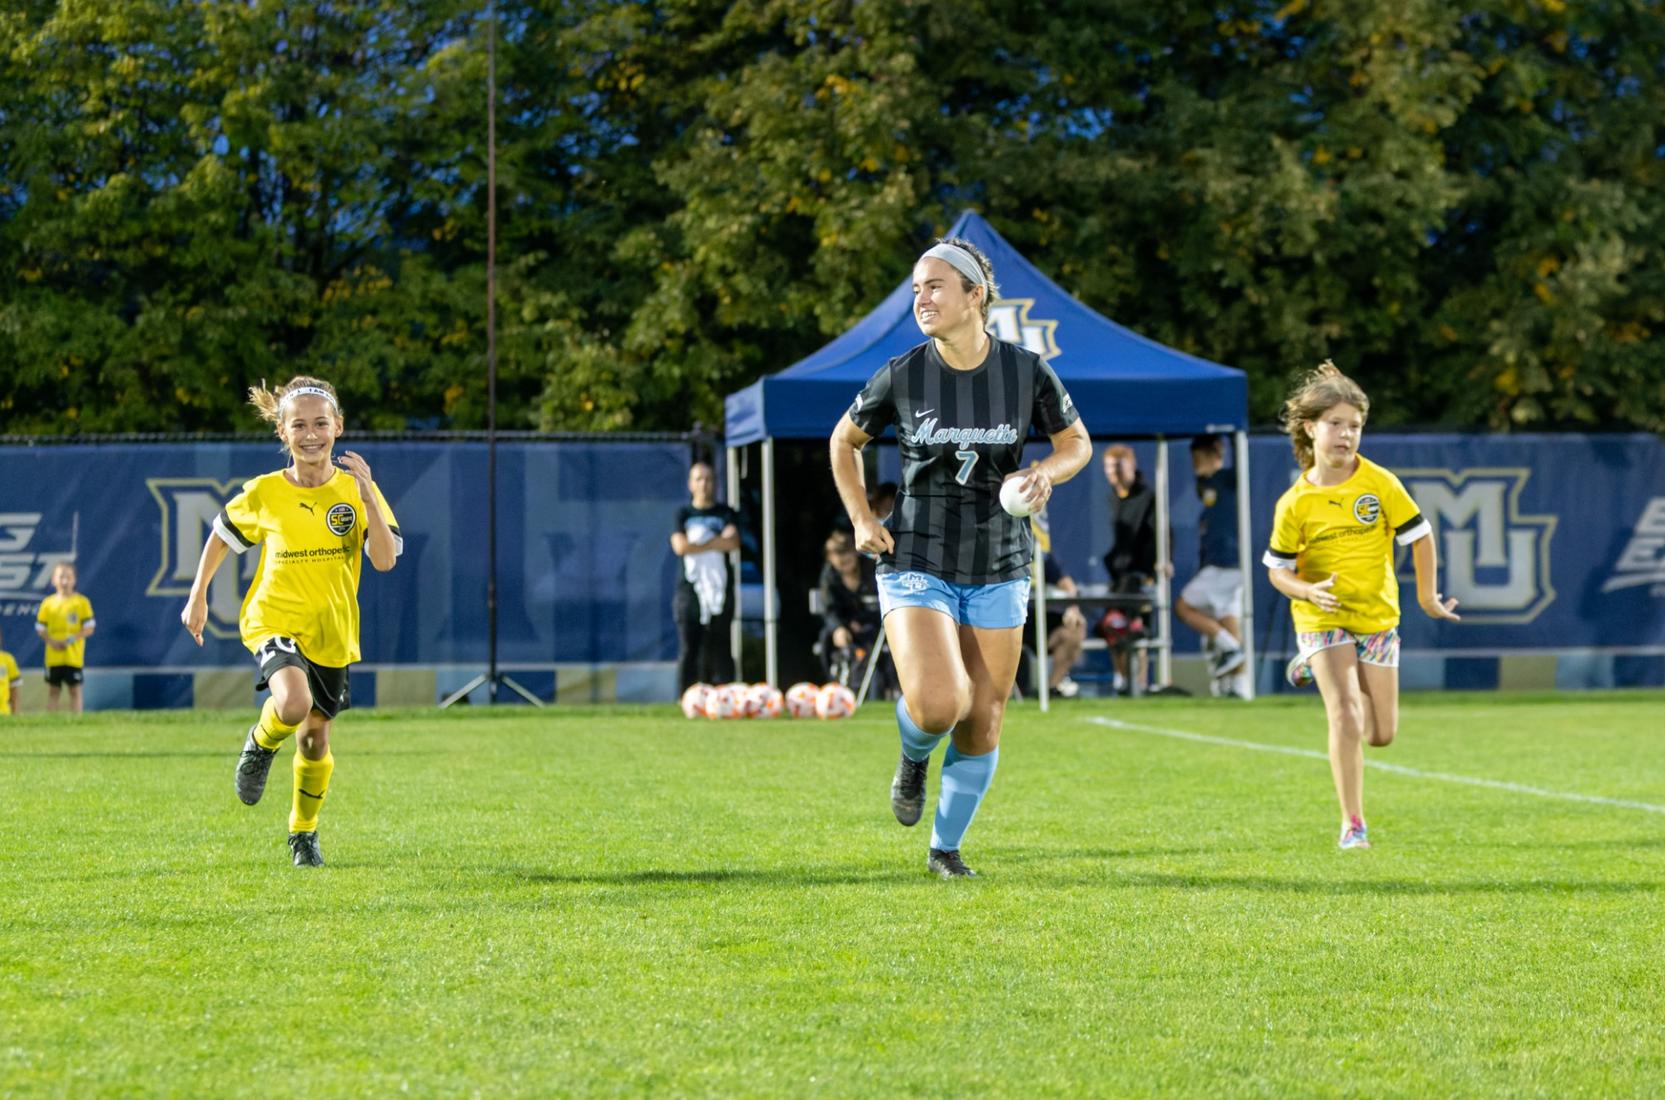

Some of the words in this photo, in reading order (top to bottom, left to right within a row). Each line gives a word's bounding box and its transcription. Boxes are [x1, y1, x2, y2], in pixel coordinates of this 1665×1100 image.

[955, 450, 979, 485] 7
[275, 548, 308, 559] midwest
[1400, 475, 1548, 616] MU
